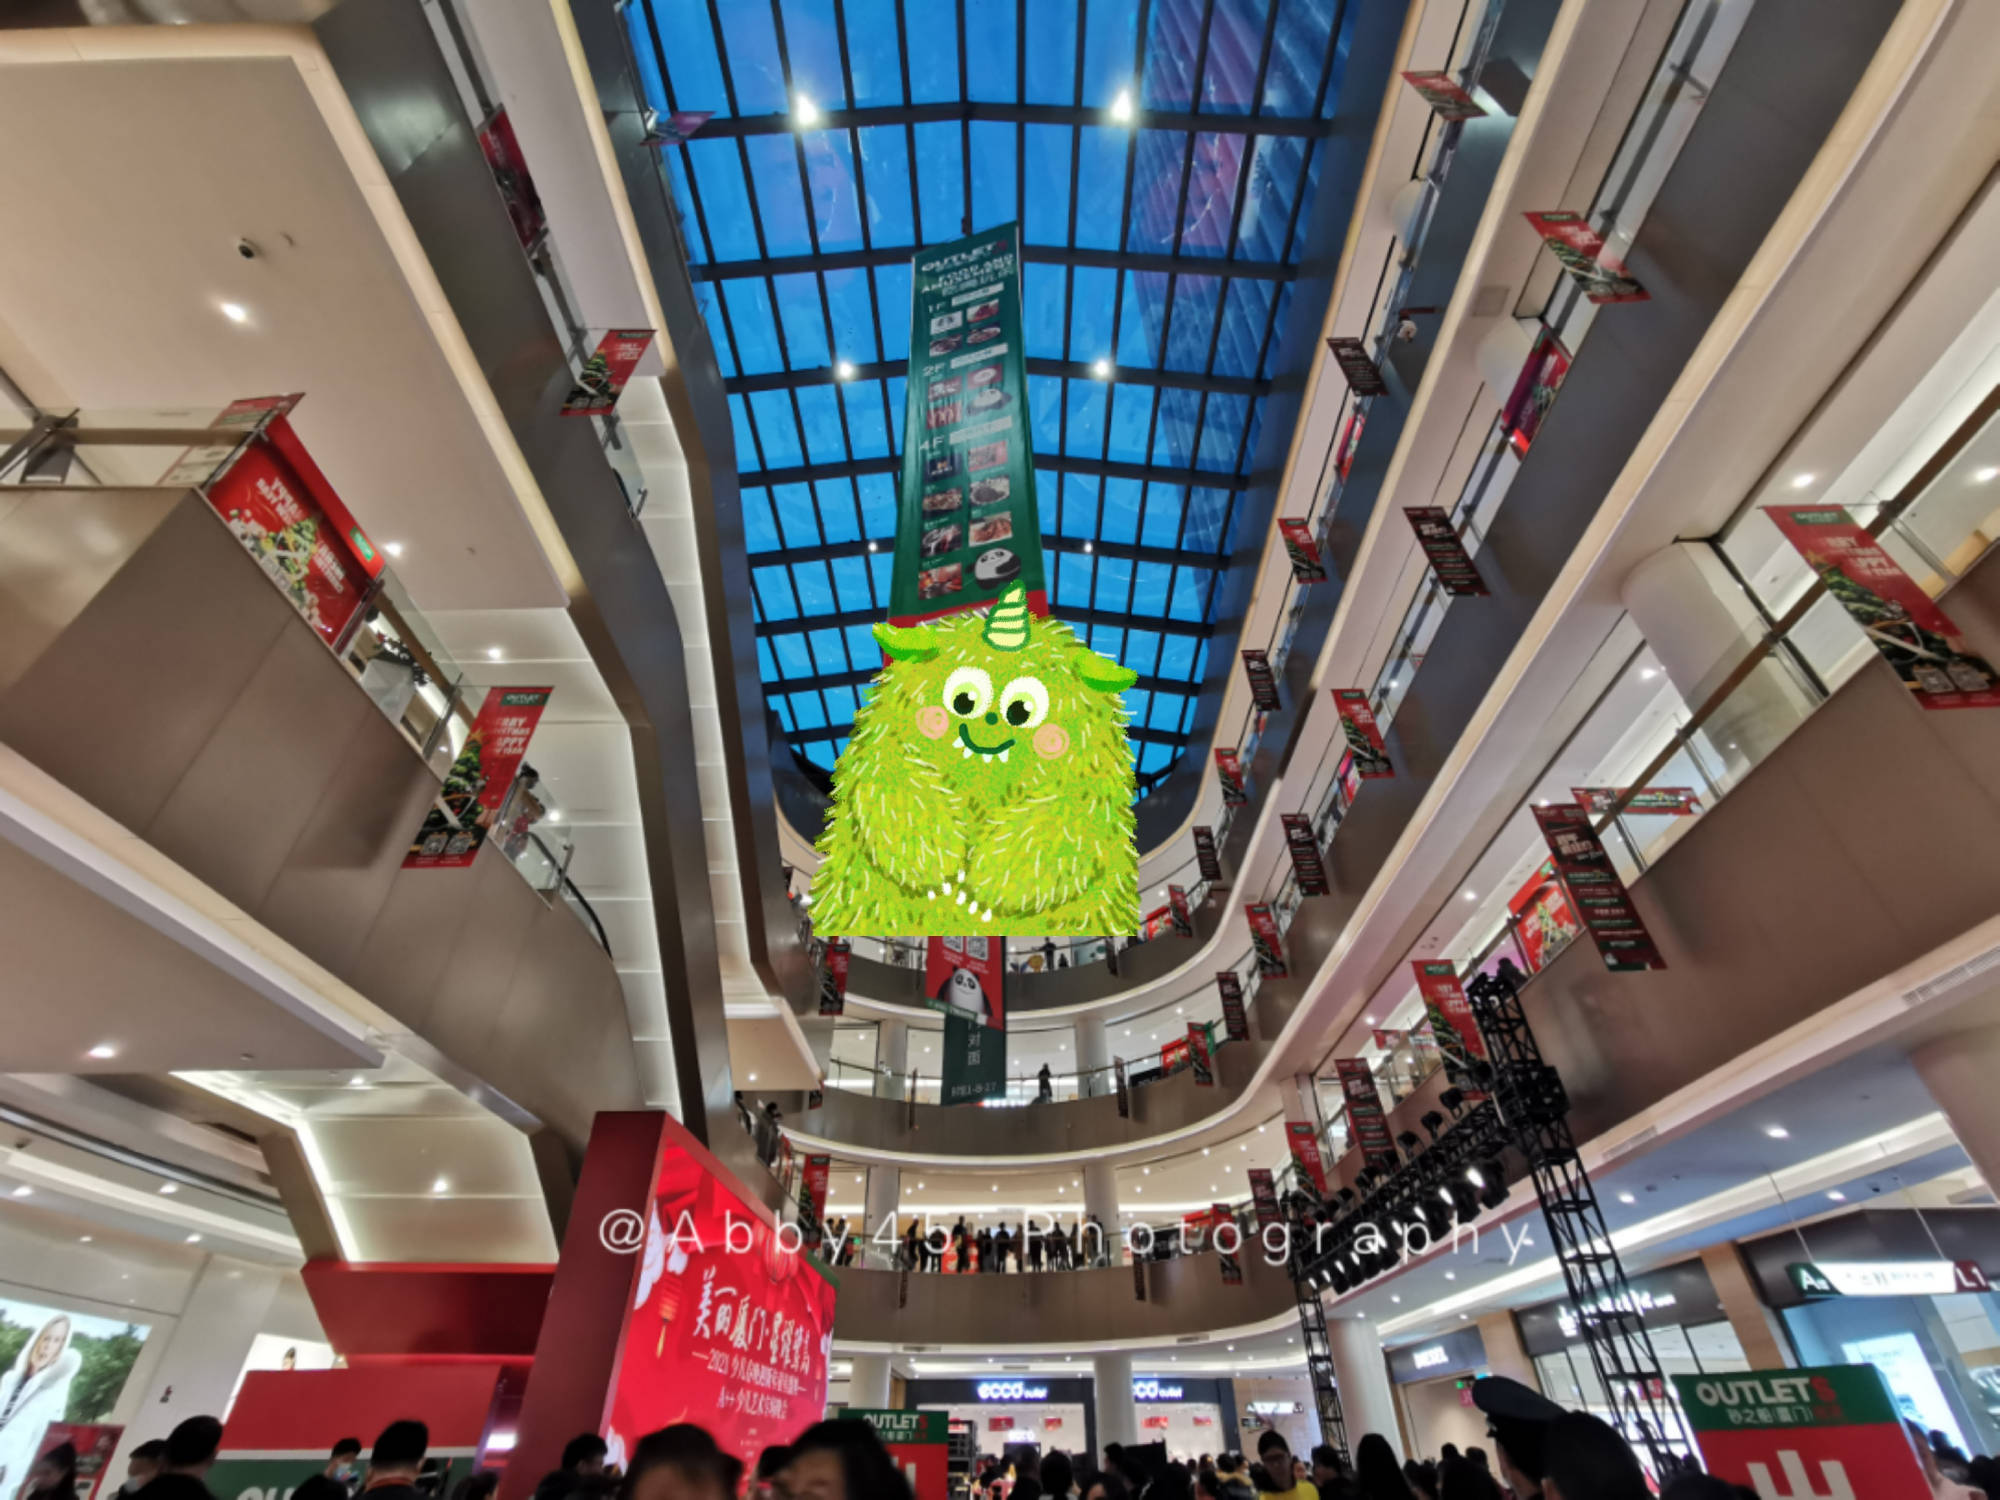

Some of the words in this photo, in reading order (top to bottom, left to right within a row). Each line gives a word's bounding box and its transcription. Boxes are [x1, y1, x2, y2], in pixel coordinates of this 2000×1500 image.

[1955, 1266, 1987, 1288] L1
[977, 1381, 1024, 1400] ecco
[1696, 1376, 1837, 1406] OUTLETS
